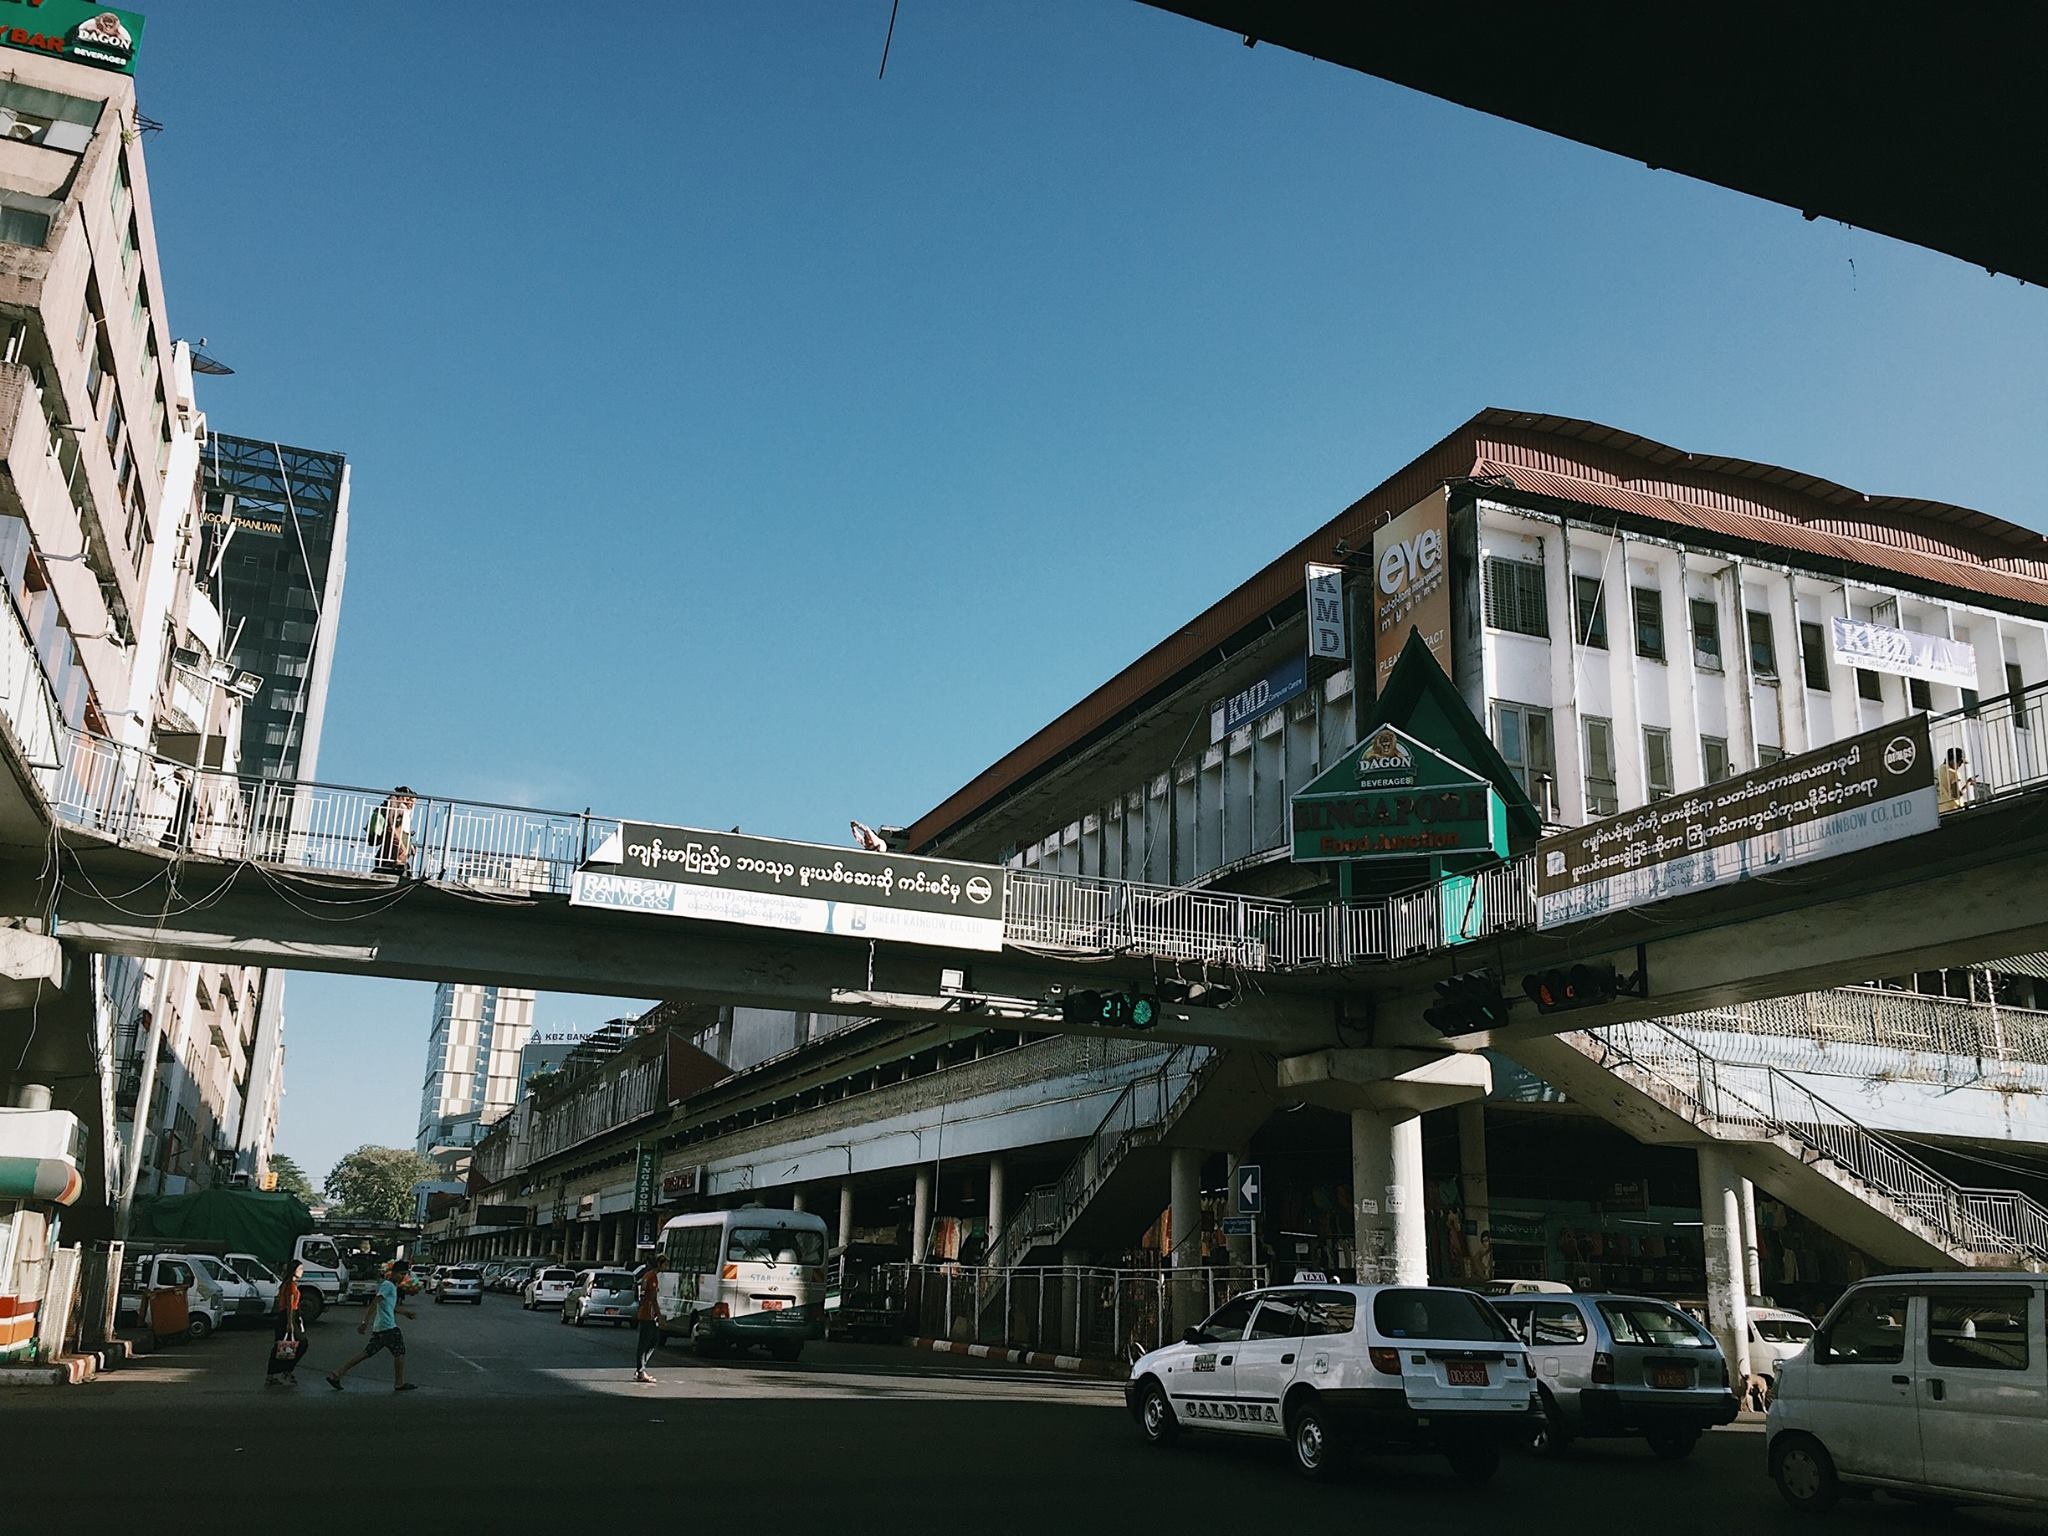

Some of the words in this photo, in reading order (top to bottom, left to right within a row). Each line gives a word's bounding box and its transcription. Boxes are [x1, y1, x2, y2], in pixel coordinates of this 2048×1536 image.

[11, 28, 65, 53] BAR
[78, 29, 131, 50] DAGON
[73, 47, 127, 65] BEVERAGES
[232, 516, 282, 533] THANLWIN
[1379, 529, 1436, 594] eye
[1315, 568, 1341, 653] KMD
[1379, 651, 1401, 672] PLEA
[1425, 629, 1444, 647] TACT
[1842, 621, 1912, 663] KMD
[1228, 679, 1270, 726] KMD
[1359, 757, 1412, 771] DAGON
[1361, 777, 1413, 788] BEVERAGES
[1295, 791, 1487, 830] SINGAPORE
[1320, 835, 1369, 853] Food
[1375, 831, 1459, 850] Junction
[585, 874, 674, 898] RAINBOW
[1544, 881, 1607, 909] RAINBOW
[618, 892, 670, 910] WORKS
[1102, 1000, 1121, 1018] 21
[545, 1033, 564, 1041] KBZ
[566, 1033, 592, 1041] BANK
[639, 1154, 651, 1213] SINGAPORE
[1303, 1273, 1325, 1282] TAXI
[1186, 1402, 1279, 1423] CALDINA
